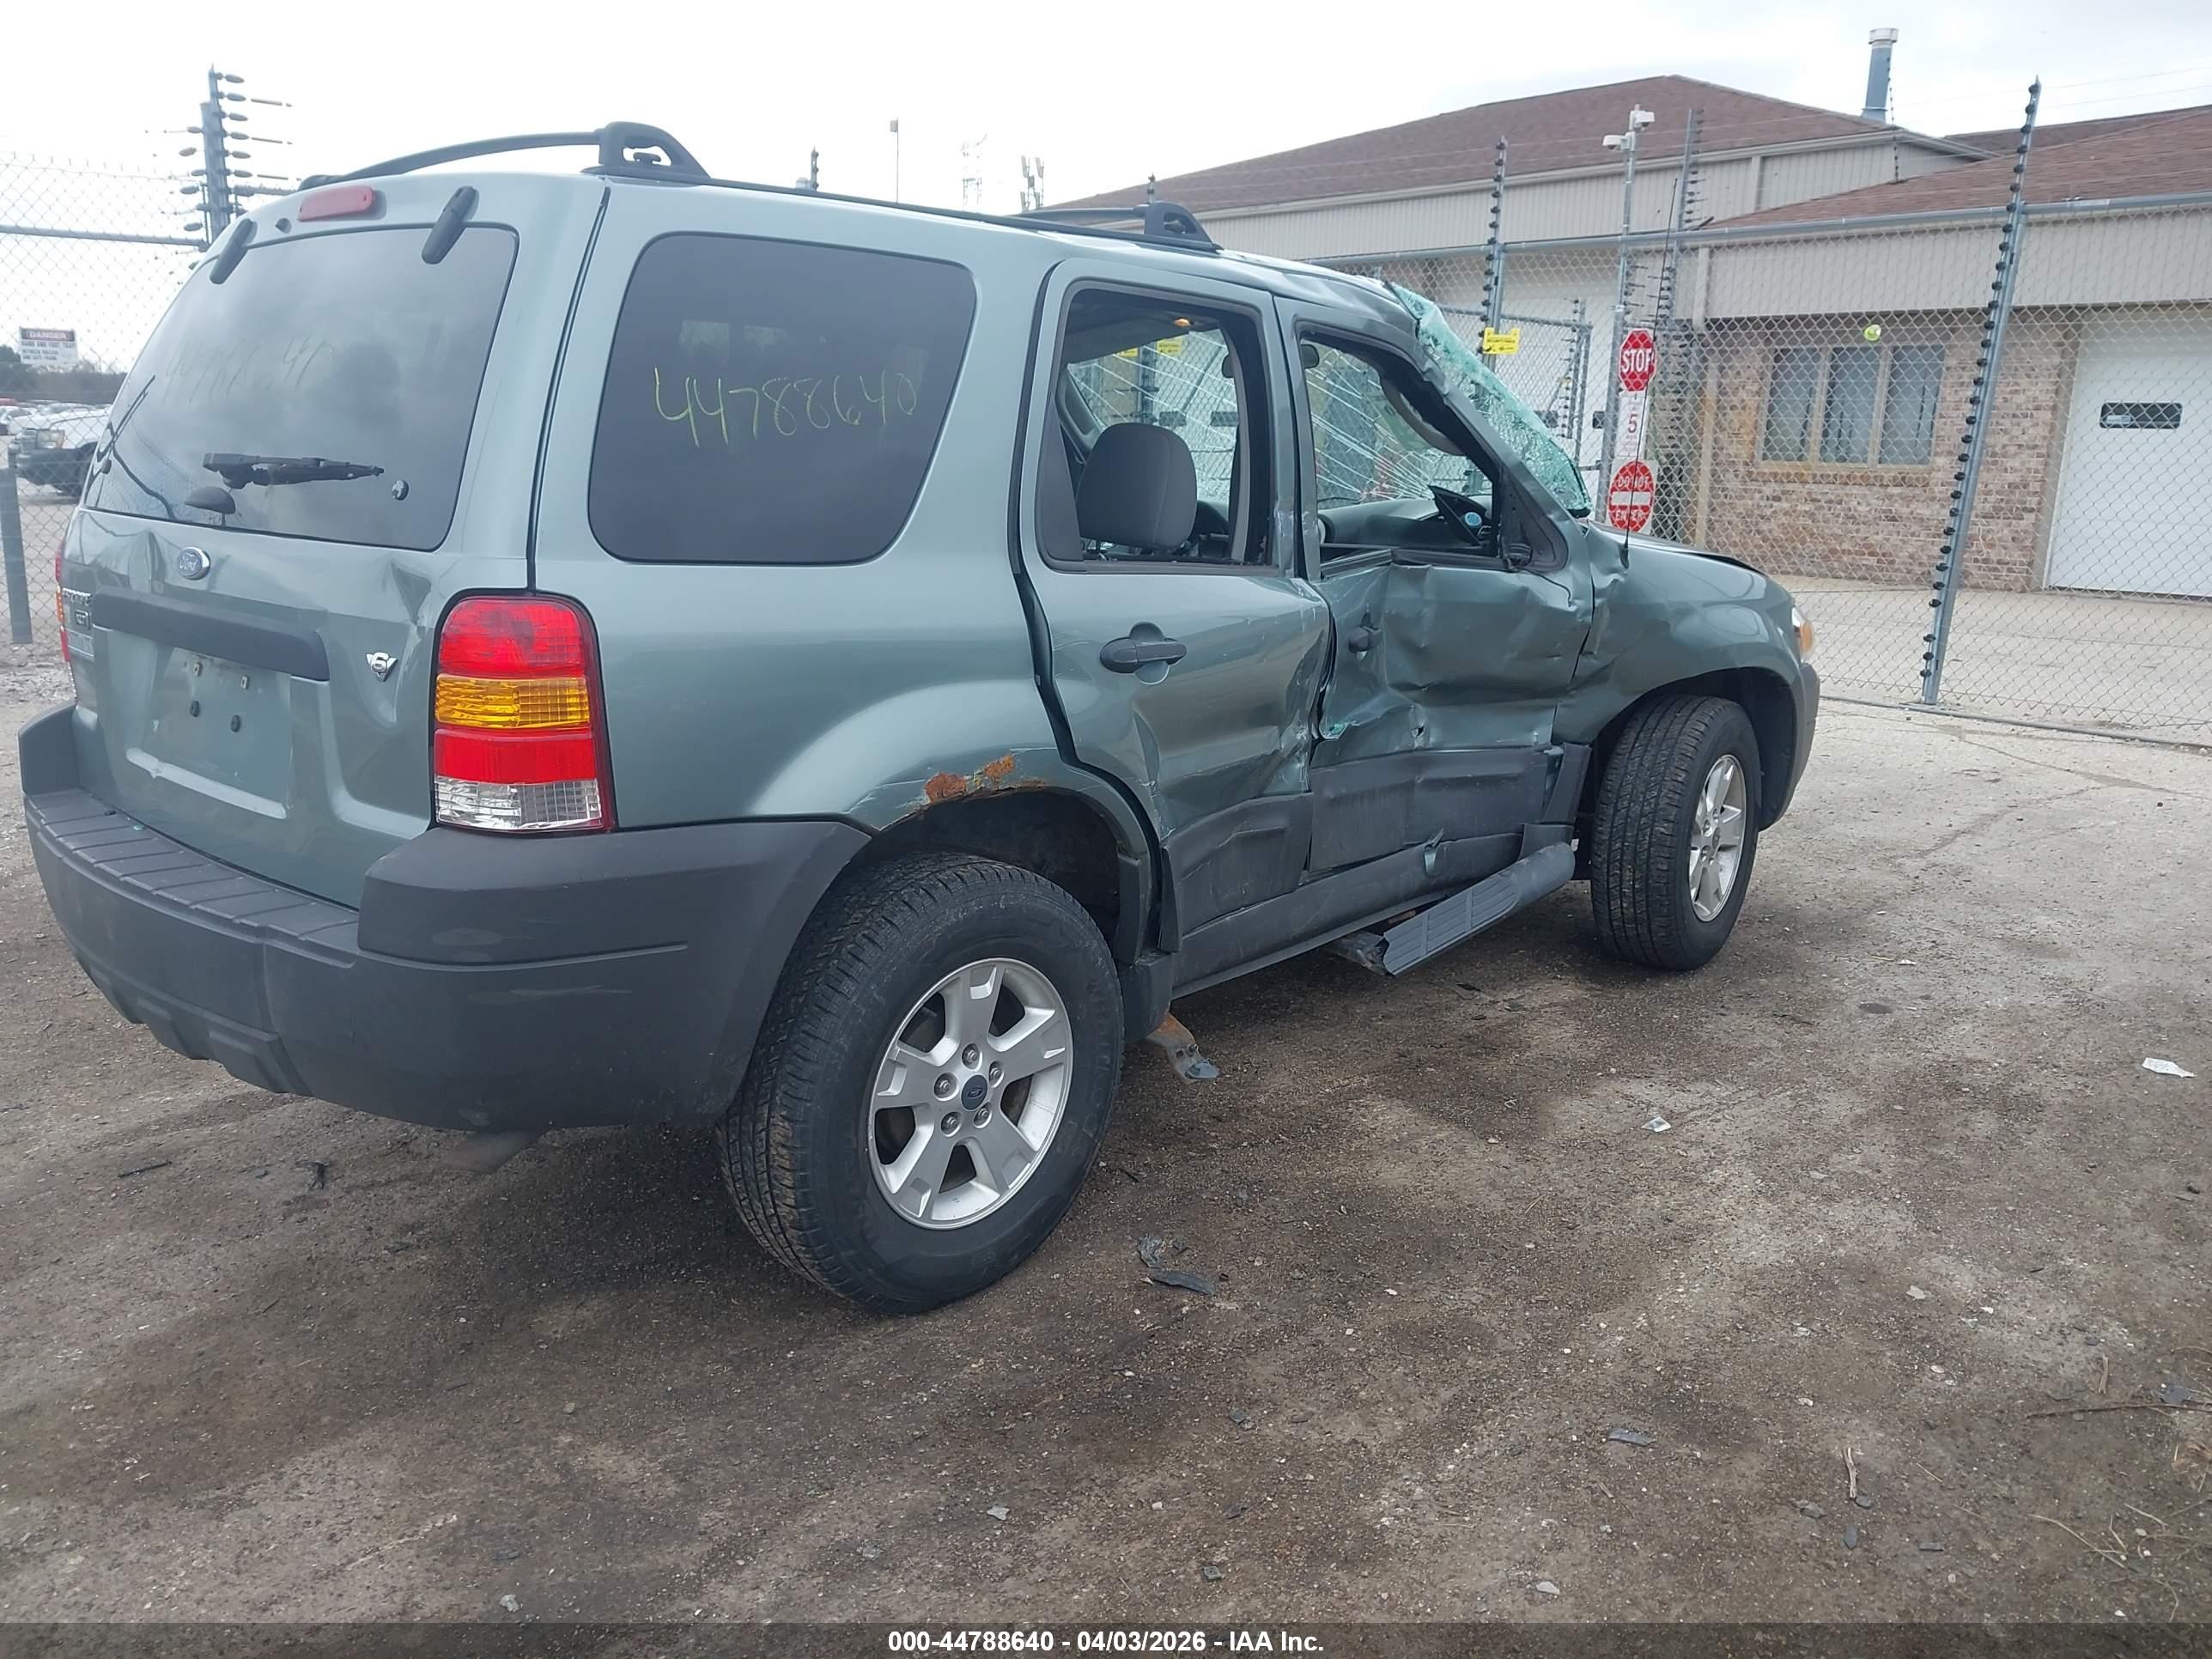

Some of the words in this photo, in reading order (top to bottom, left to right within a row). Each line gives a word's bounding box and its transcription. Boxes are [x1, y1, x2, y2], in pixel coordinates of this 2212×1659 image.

[1621, 349, 1655, 373] STOP
[653, 366, 918, 447] 44788640
[1627, 413, 1638, 434] 5
[1618, 476, 1630, 488] DO
[1615, 509, 1644, 522] ENER
[179, 552, 199, 571] Ford
